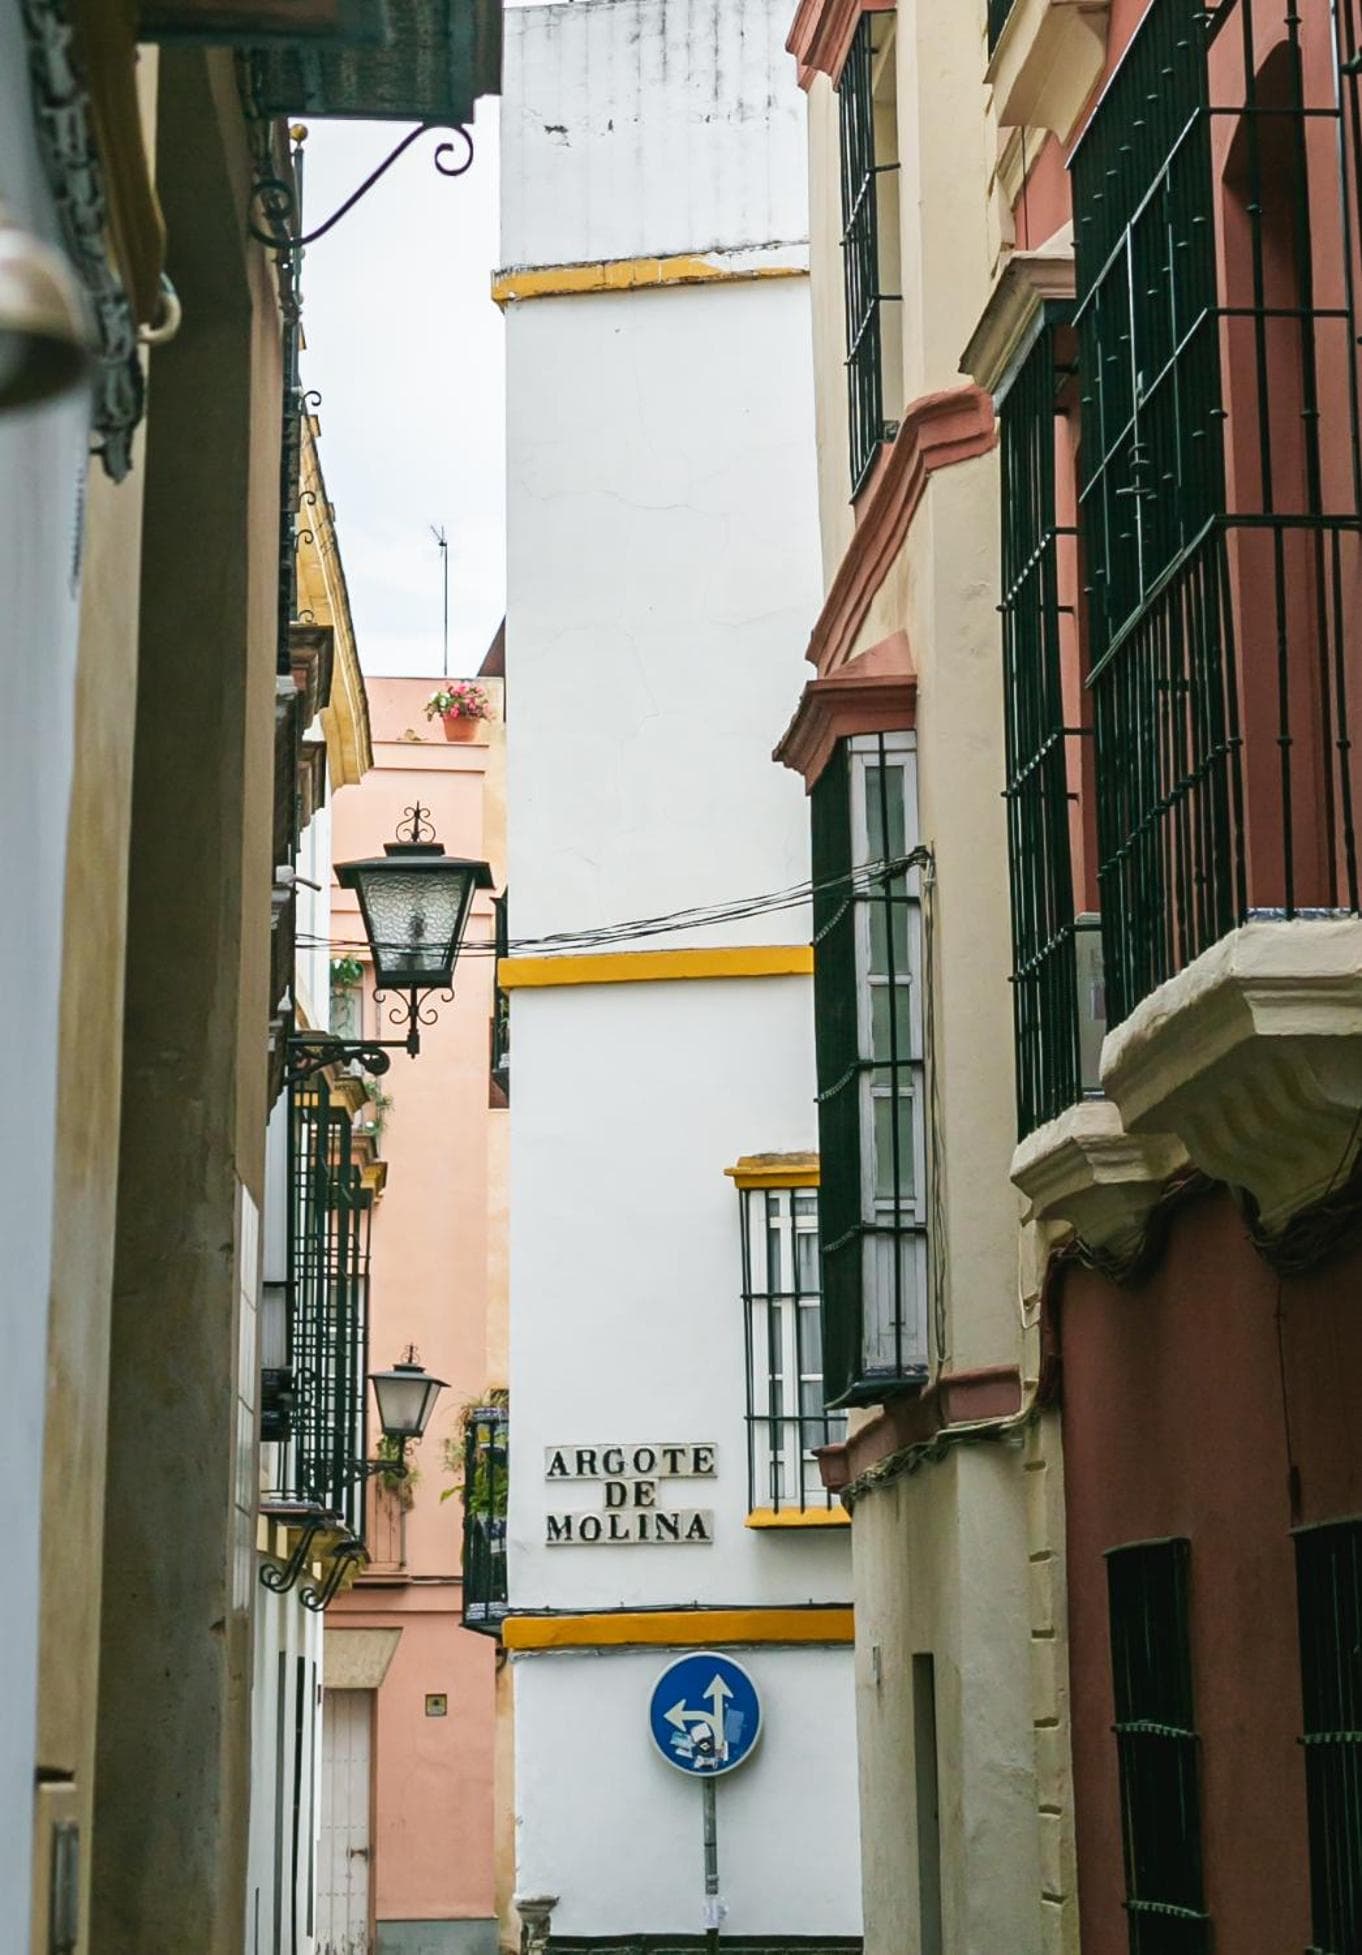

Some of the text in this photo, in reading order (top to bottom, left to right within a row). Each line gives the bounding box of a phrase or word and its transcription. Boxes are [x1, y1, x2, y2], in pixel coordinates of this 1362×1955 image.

[547, 1447, 714, 1476] ARGOTE
[605, 1480, 656, 1508] DE
[546, 1512, 709, 1541] MOLINA
